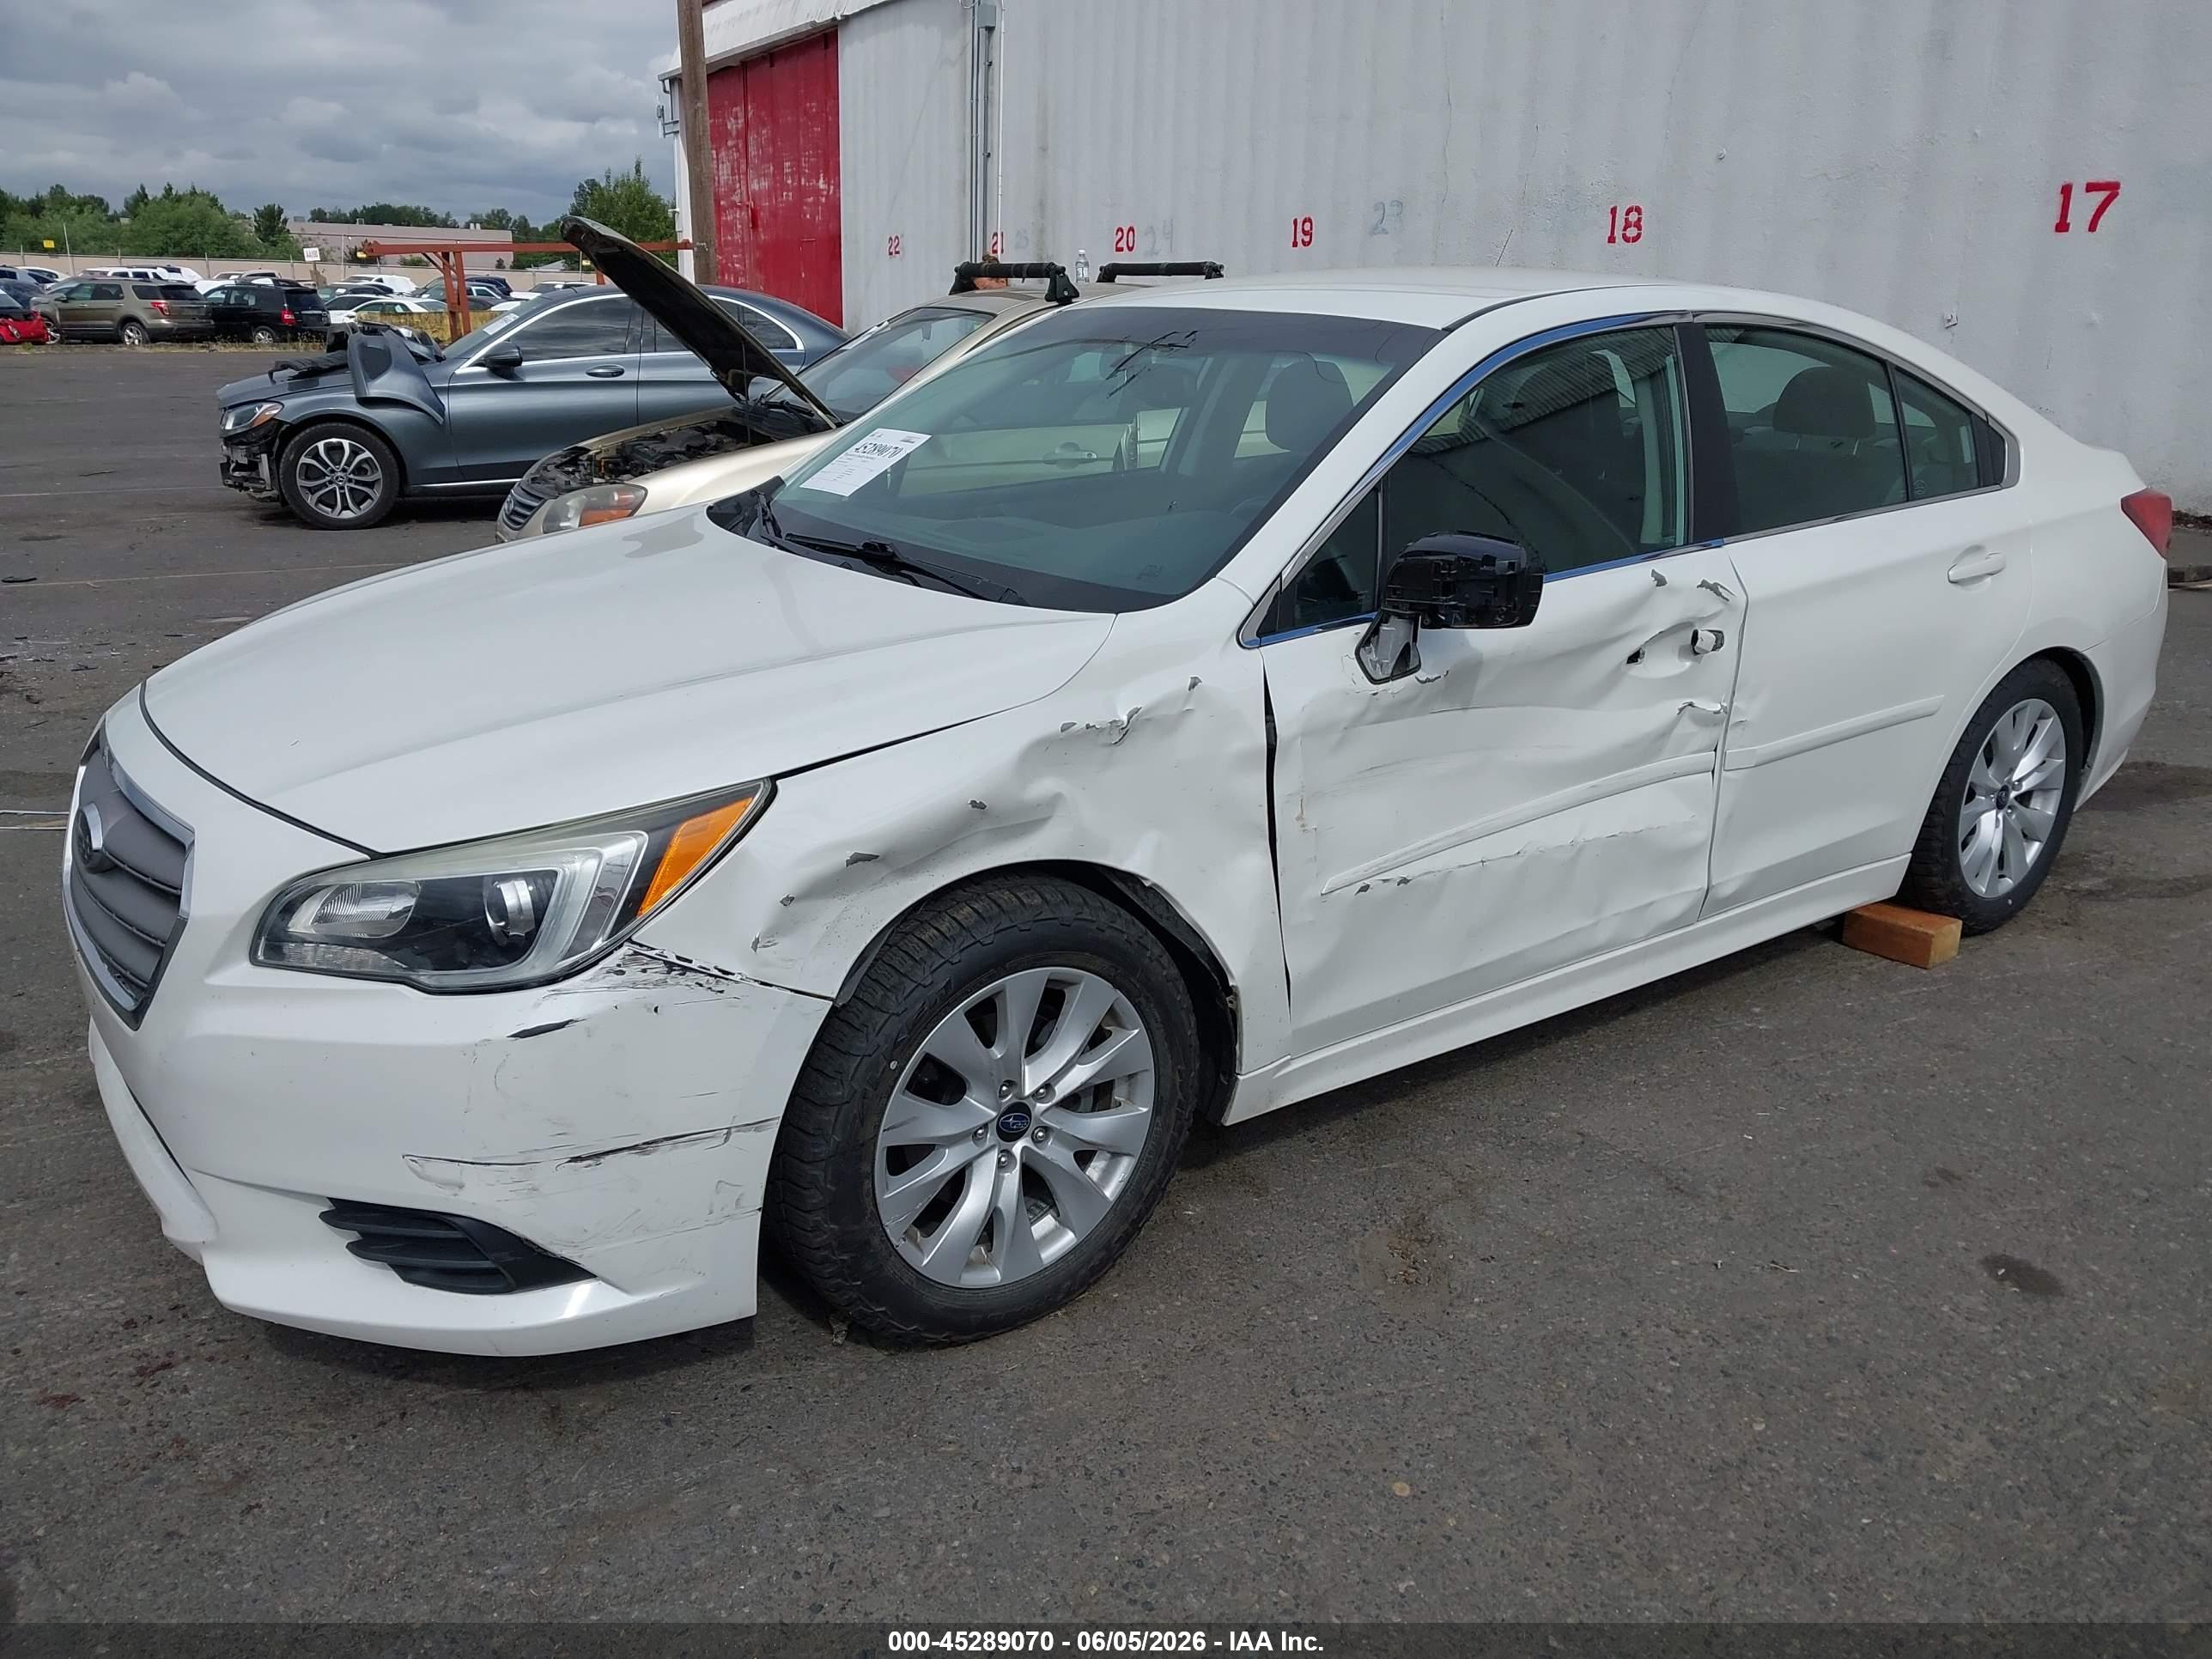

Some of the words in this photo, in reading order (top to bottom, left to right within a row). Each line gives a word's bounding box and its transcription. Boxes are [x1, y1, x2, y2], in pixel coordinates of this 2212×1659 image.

[2054, 181, 2121, 233] 17
[1115, 226, 1136, 252] 20
[1291, 216, 1314, 248] 19
[1607, 205, 1643, 244] 18
[888, 235, 901, 256] 22
[992, 231, 1005, 254] 21
